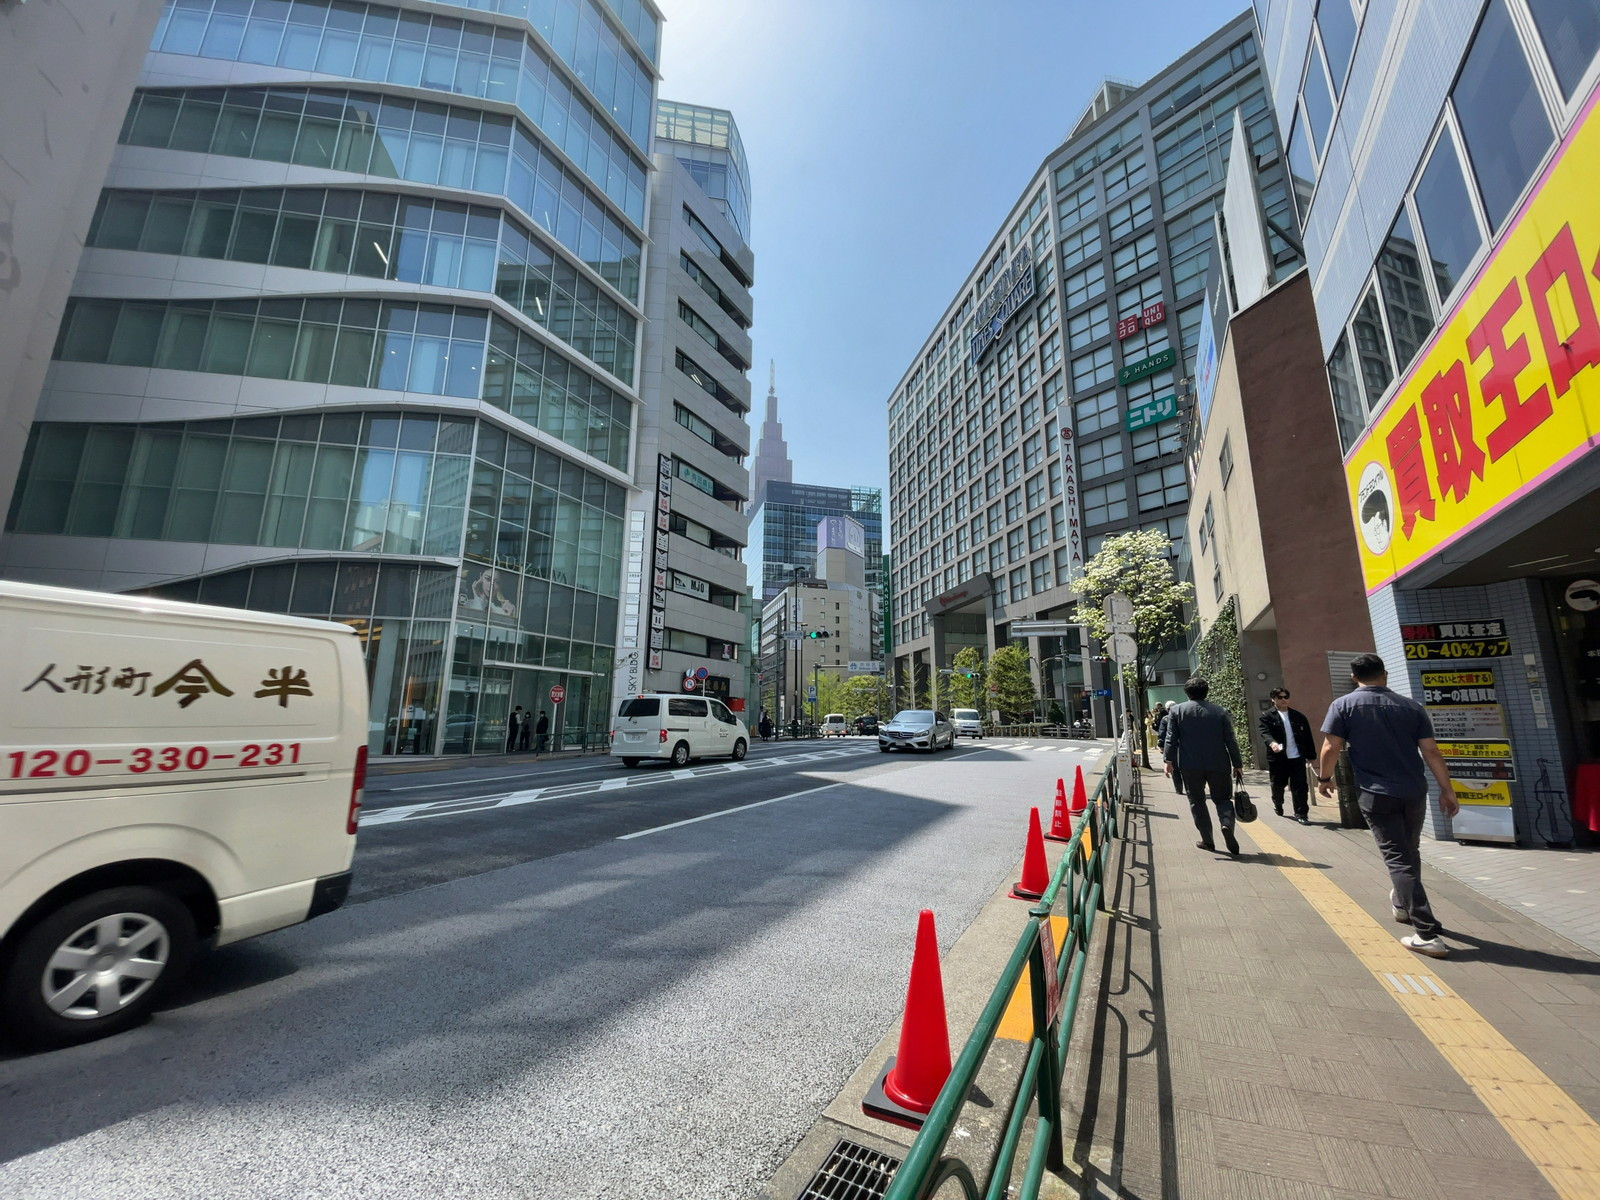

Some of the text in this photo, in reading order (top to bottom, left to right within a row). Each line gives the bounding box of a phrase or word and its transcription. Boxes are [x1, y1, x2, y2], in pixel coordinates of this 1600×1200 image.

[1143, 305, 1160, 318] UNI
[1144, 312, 1162, 325] QLO
[1134, 354, 1169, 374] HANDS
[1385, 220, 1600, 541] 買取王ロ
[1129, 398, 1172, 428] ニトリ
[1064, 443, 1081, 561] TAKASHIMAYA
[628, 675, 637, 691] SKY
